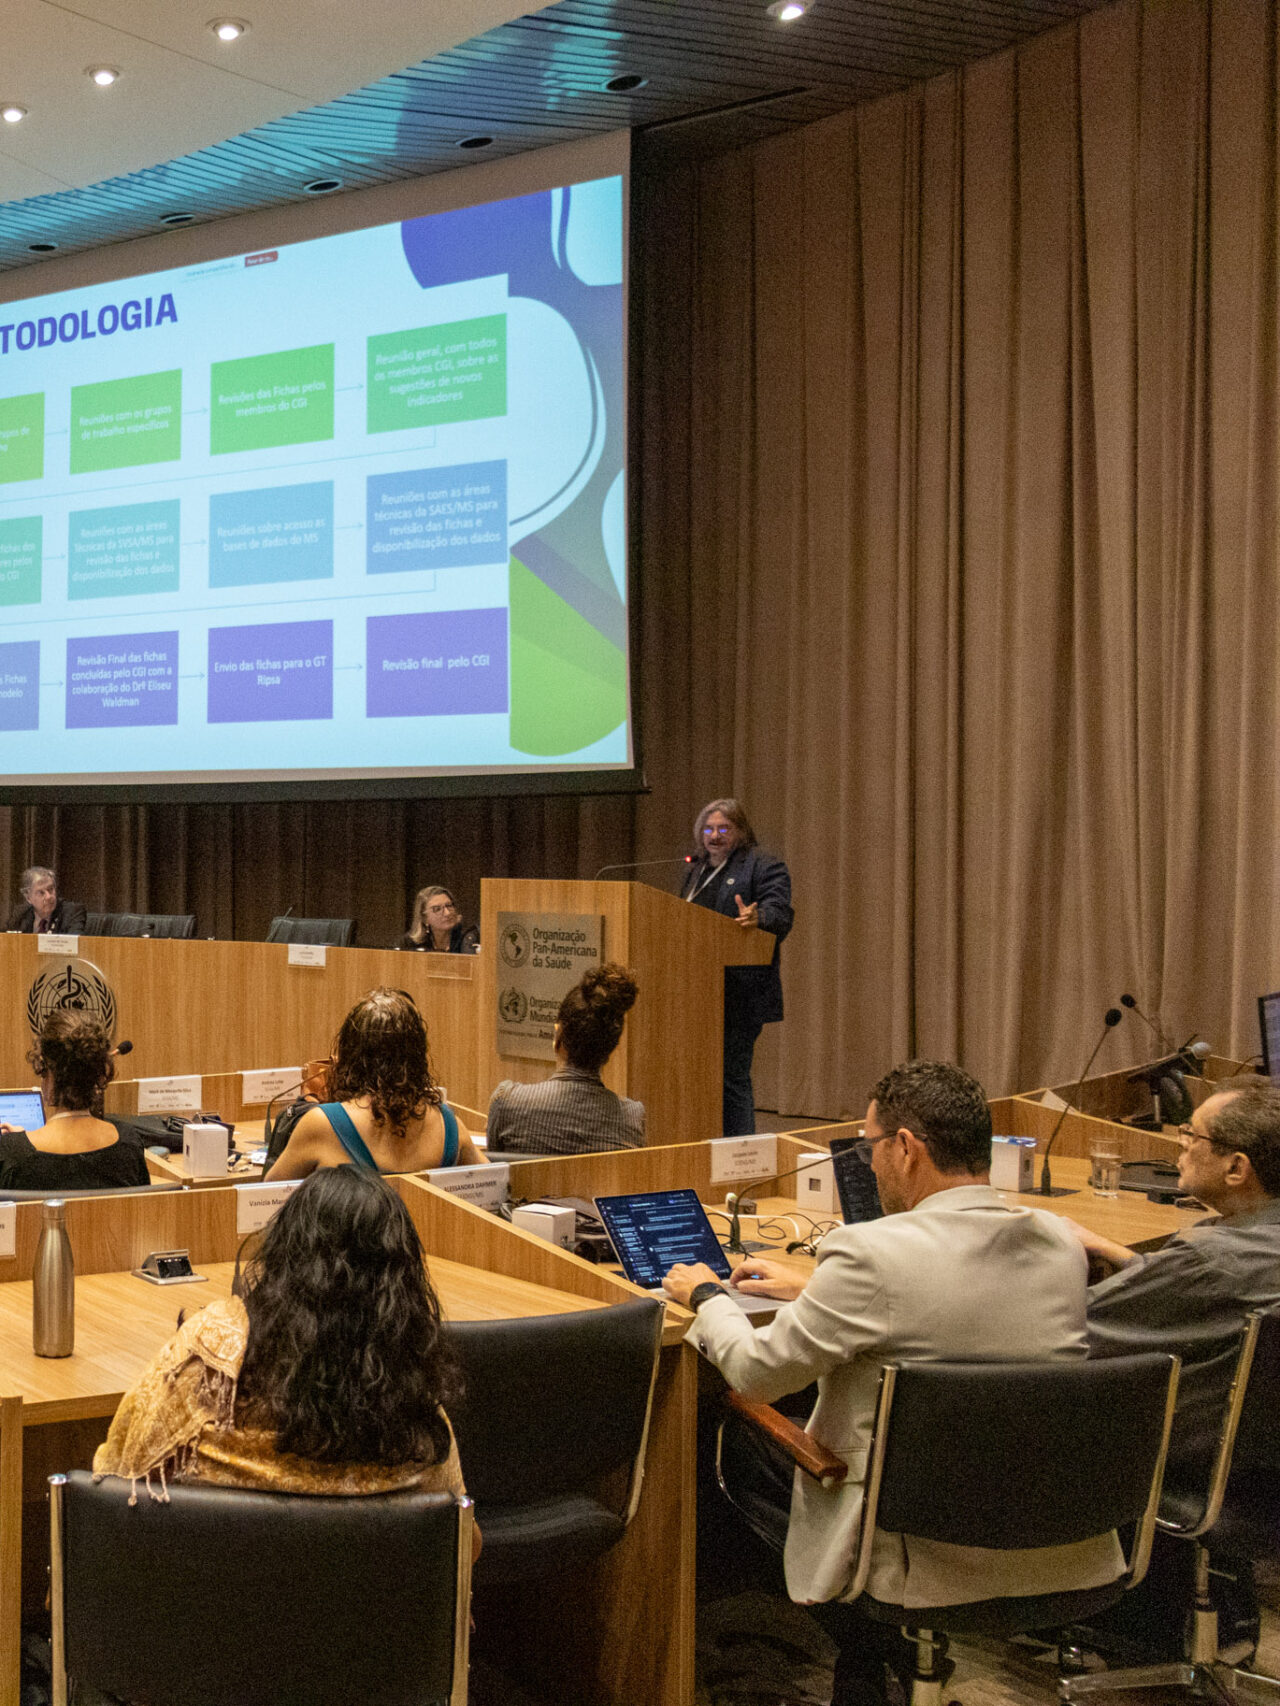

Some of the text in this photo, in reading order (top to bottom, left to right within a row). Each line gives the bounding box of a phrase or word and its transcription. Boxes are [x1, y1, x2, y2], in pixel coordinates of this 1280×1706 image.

[376, 337, 497, 366] Reunião geral, com todos
[374, 372, 386, 381] os
[387, 364, 433, 378] membros
[456, 355, 485, 368] sobre
[487, 354, 499, 363] as
[389, 372, 483, 395] sugestões de novos
[219, 392, 255, 405] Revisões
[257, 388, 271, 400] das
[302, 381, 326, 394] pelos
[236, 397, 308, 417] membros do CGI
[79, 413, 113, 427] Reuniões
[115, 411, 132, 421] com
[144, 405, 172, 419] grupos
[81, 430, 91, 440] de
[92, 426, 125, 438] trabalho
[381, 483, 491, 505] Reuniões com as áreas
[414, 506, 427, 518] da
[428, 500, 475, 516] SAES/MS
[475, 500, 498, 513] para
[80, 525, 115, 538] Reuniões
[116, 524, 134, 535] com
[217, 524, 256, 537] Reuniões
[258, 521, 282, 534] sobre
[284, 519, 313, 531] acesso
[389, 518, 483, 536] revisão das fichas e
[155, 535, 174, 546] para
[223, 533, 319, 552] bases de dados do MS
[372, 530, 500, 554] disponibilização dos dados
[77, 651, 167, 666] Revisão Final das fichas
[214, 655, 327, 673] Envio das fichas para o GT
[382, 654, 490, 671] Revisão final pelo CGI
[71, 666, 172, 681] concluídas pelo CGI com a
[257, 675, 281, 687] Ripsa
[71, 679, 172, 696] colaboração do Eliseu
[101, 696, 140, 708] Waldman
[532, 927, 586, 944] Organização
[532, 942, 598, 957] Pan-Americana
[532, 956, 572, 970] da Saúde
[529, 1009, 558, 1023] Mundia
[444, 1183, 475, 1193] ALESSANDRA
